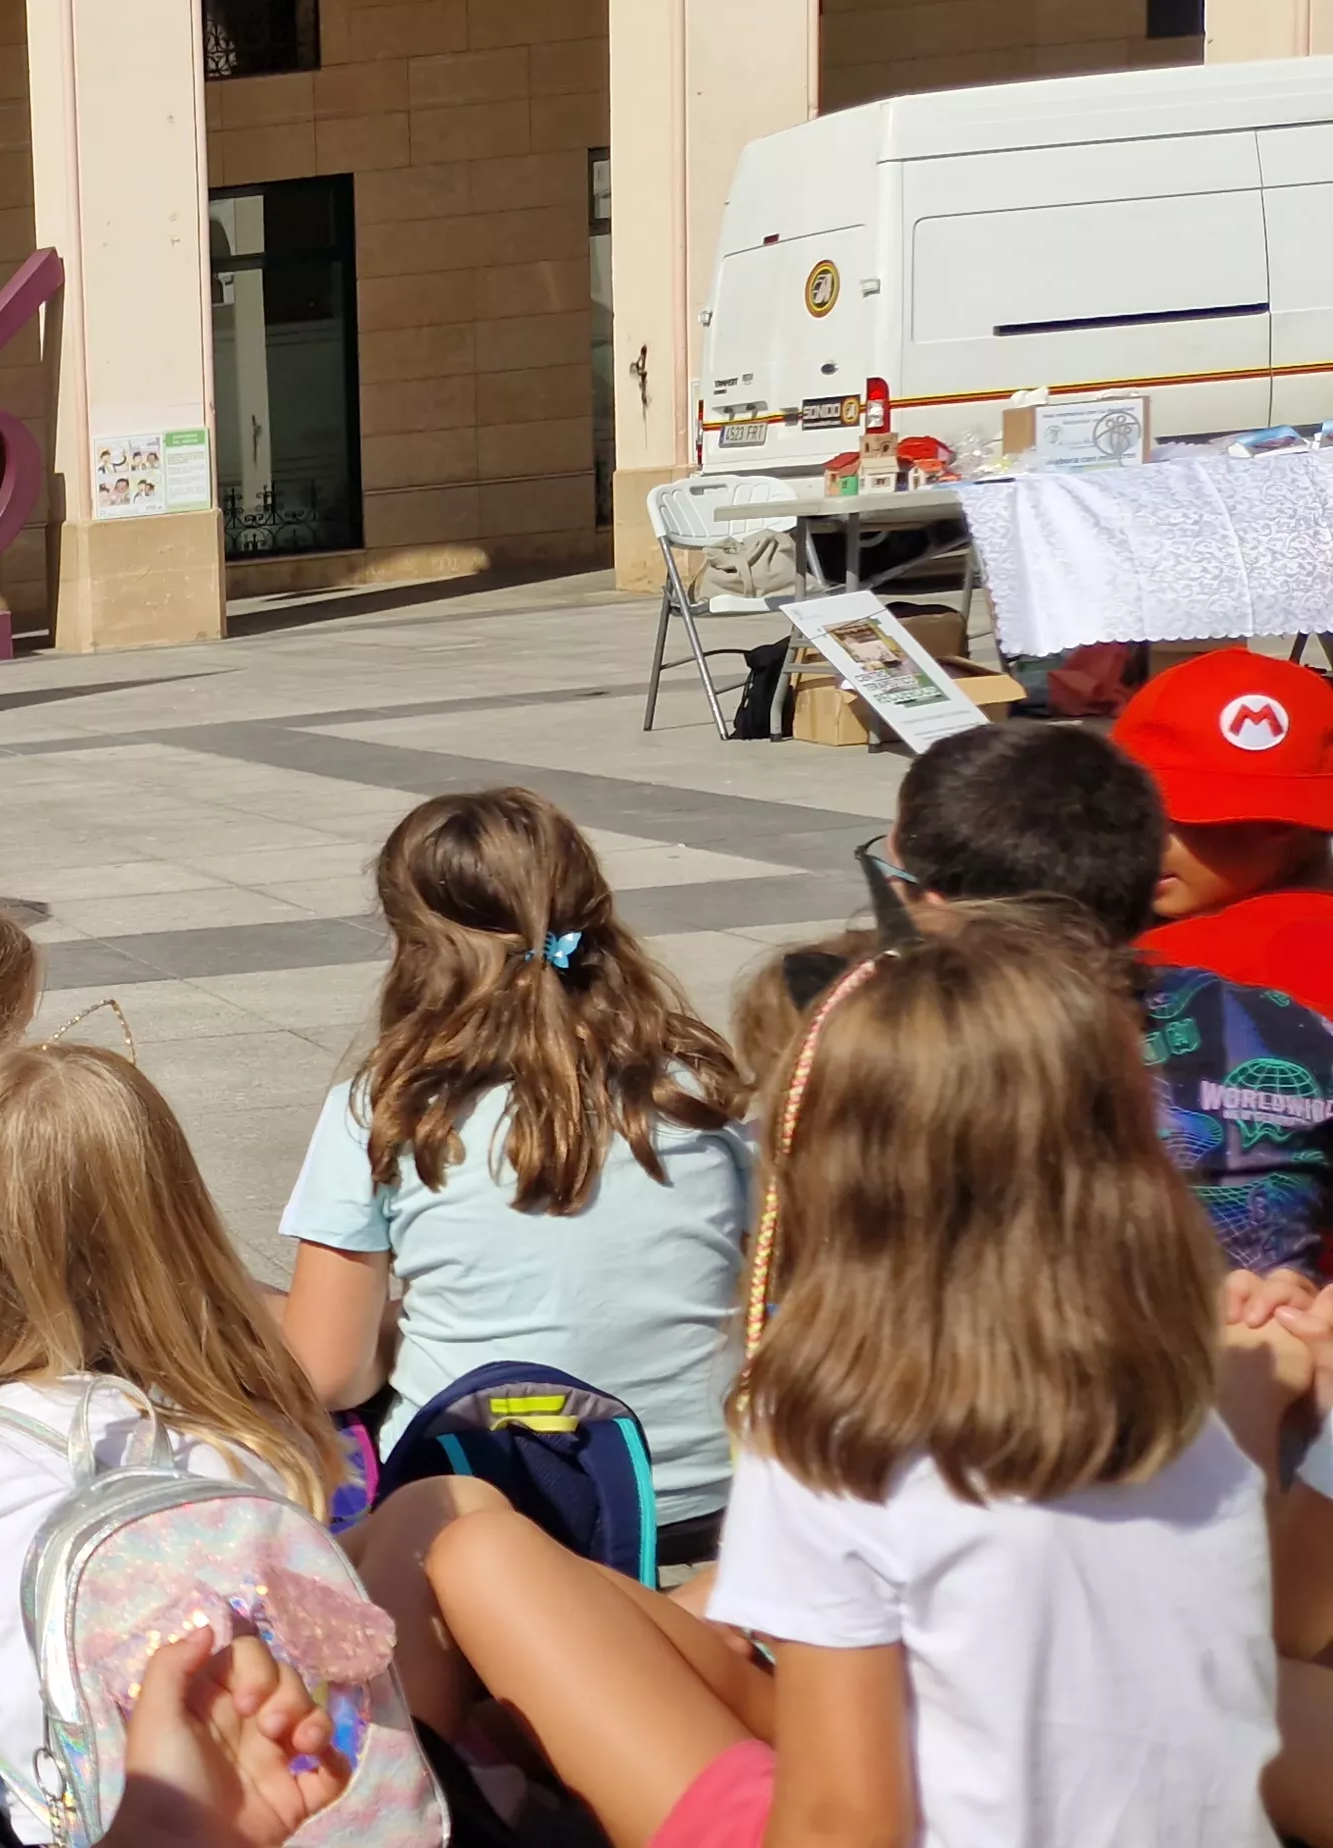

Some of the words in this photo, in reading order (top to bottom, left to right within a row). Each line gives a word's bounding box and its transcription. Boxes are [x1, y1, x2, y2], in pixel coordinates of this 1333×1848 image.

[725, 426, 744, 441] 4523
[746, 425, 764, 440] FRT
[1229, 703, 1284, 737] M
